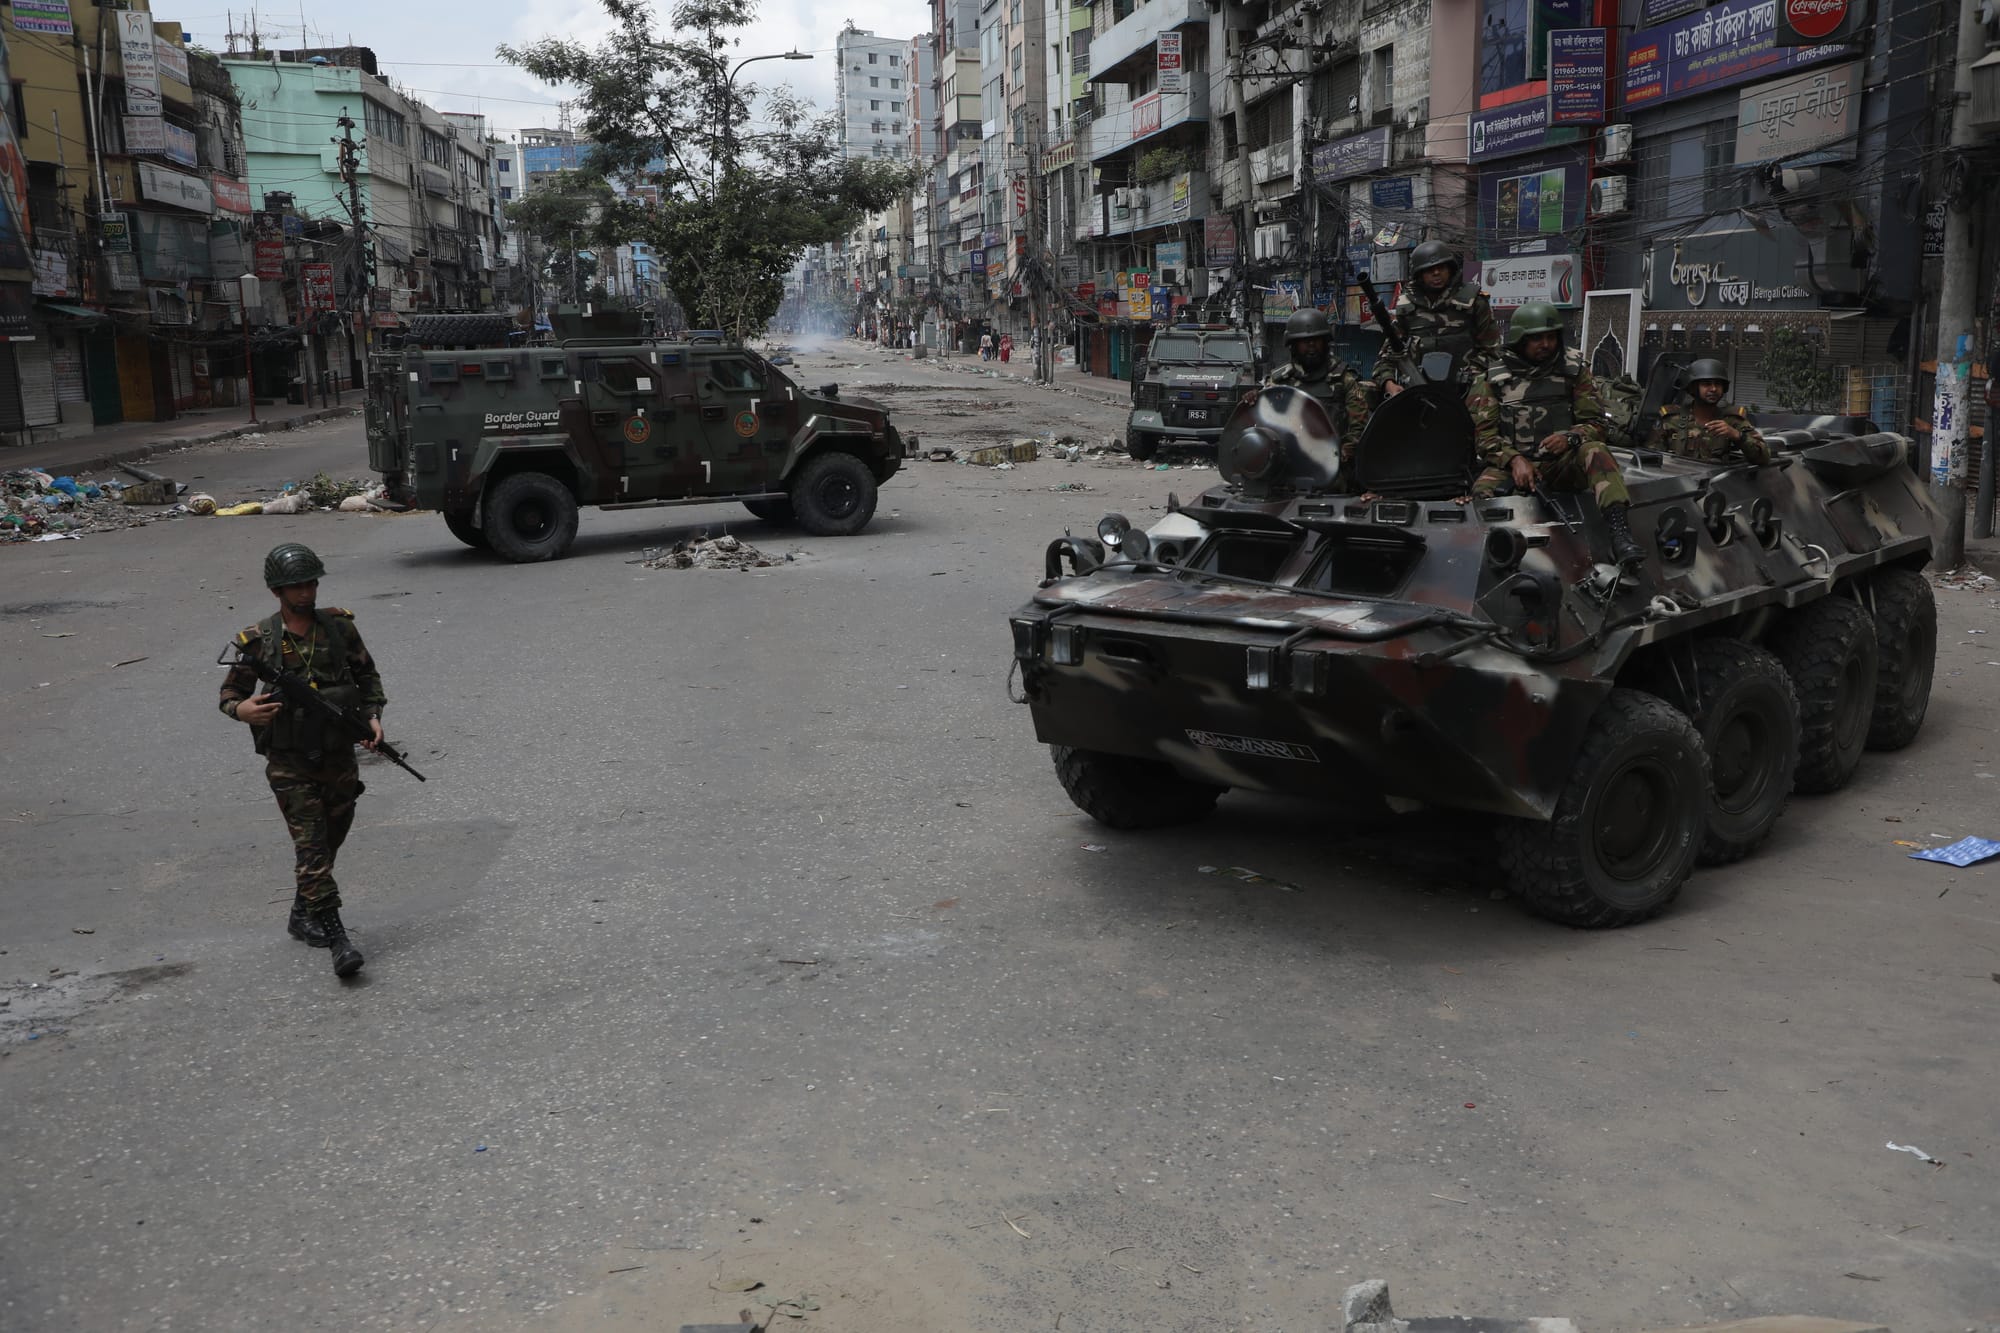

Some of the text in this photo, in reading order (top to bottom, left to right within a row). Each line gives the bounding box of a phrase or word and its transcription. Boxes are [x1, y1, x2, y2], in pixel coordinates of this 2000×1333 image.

[1691, 11, 1714, 52] কাজী
[1748, 2, 1777, 41] সুলতা
[1804, 72, 1847, 123] নীড়
[1754, 288, 1780, 302] Bengali
[485, 410, 560, 423] Border Guard
[502, 422, 542, 430] Bangladesh
